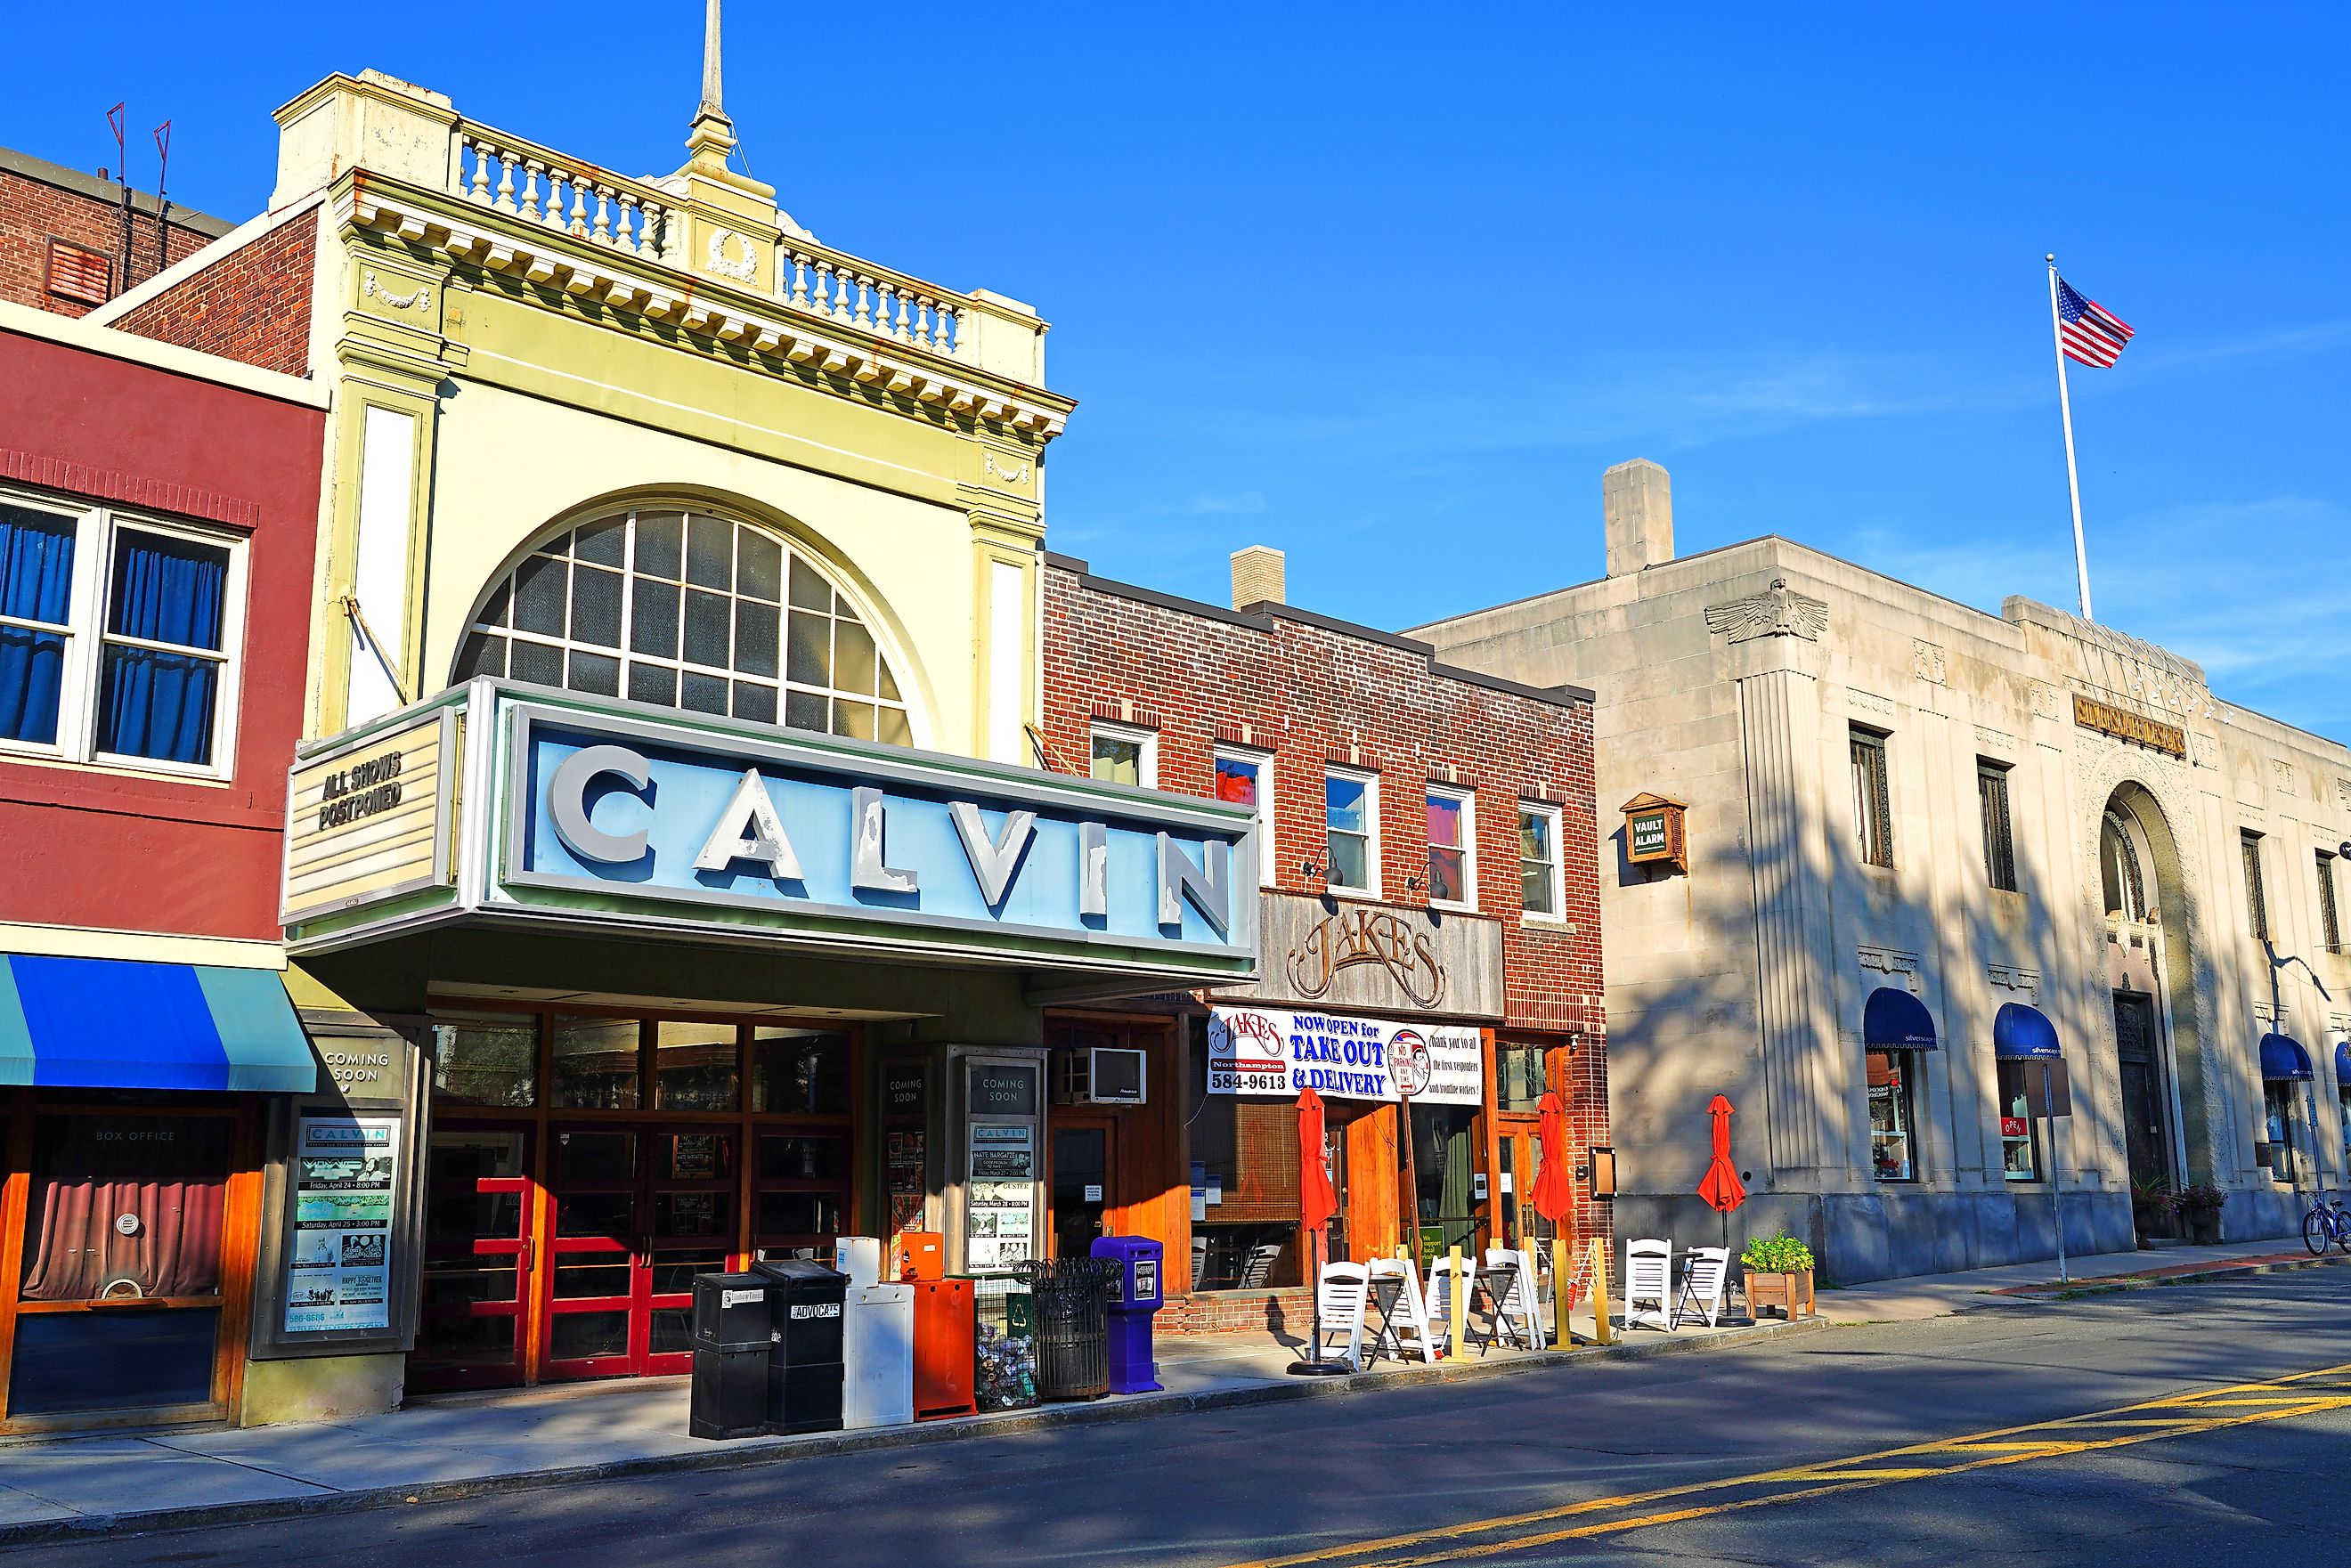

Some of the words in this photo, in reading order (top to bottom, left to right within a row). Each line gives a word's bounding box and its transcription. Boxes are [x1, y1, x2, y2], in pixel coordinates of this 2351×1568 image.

[322, 771, 348, 800] ALL
[351, 751, 402, 790] SHOWS
[318, 781, 402, 831] POSTPONED
[1634, 819, 1663, 833] VAULT
[546, 744, 1232, 932] CALVIN
[1635, 832, 1664, 847] ALARM
[1287, 909, 1446, 1010] JAKES
[1292, 1015, 1325, 1031] NOW
[1326, 1018, 1359, 1036] OPEN
[1361, 1022, 1379, 1038] for
[1209, 1012, 1285, 1057] JAKES
[1289, 1034, 1342, 1064] TAKE
[1343, 1039, 1385, 1068] OUT
[1398, 1044, 1406, 1056] NO
[324, 1052, 389, 1066] COMING
[1212, 1060, 1284, 1070] Northampton
[1393, 1057, 1413, 1068] PARKING
[334, 1068, 378, 1082] SOON
[1211, 1073, 1286, 1090] 584-9613
[891, 1078, 922, 1090] COMING
[982, 1078, 1024, 1089] COMING
[1292, 1068, 1306, 1091] &
[1309, 1068, 1387, 1097] DELIVERY
[894, 1092, 916, 1102] SOON
[989, 1092, 1017, 1101] SOON
[978, 1129, 1025, 1137] CALVIN
[2005, 1120, 2022, 1133] OPEN
[96, 1132, 123, 1141] BOX
[129, 1132, 175, 1141] OFFICE
[312, 1129, 385, 1140] CALVIN
[329, 1182, 343, 1190] April
[1423, 1240, 1442, 1248] support
